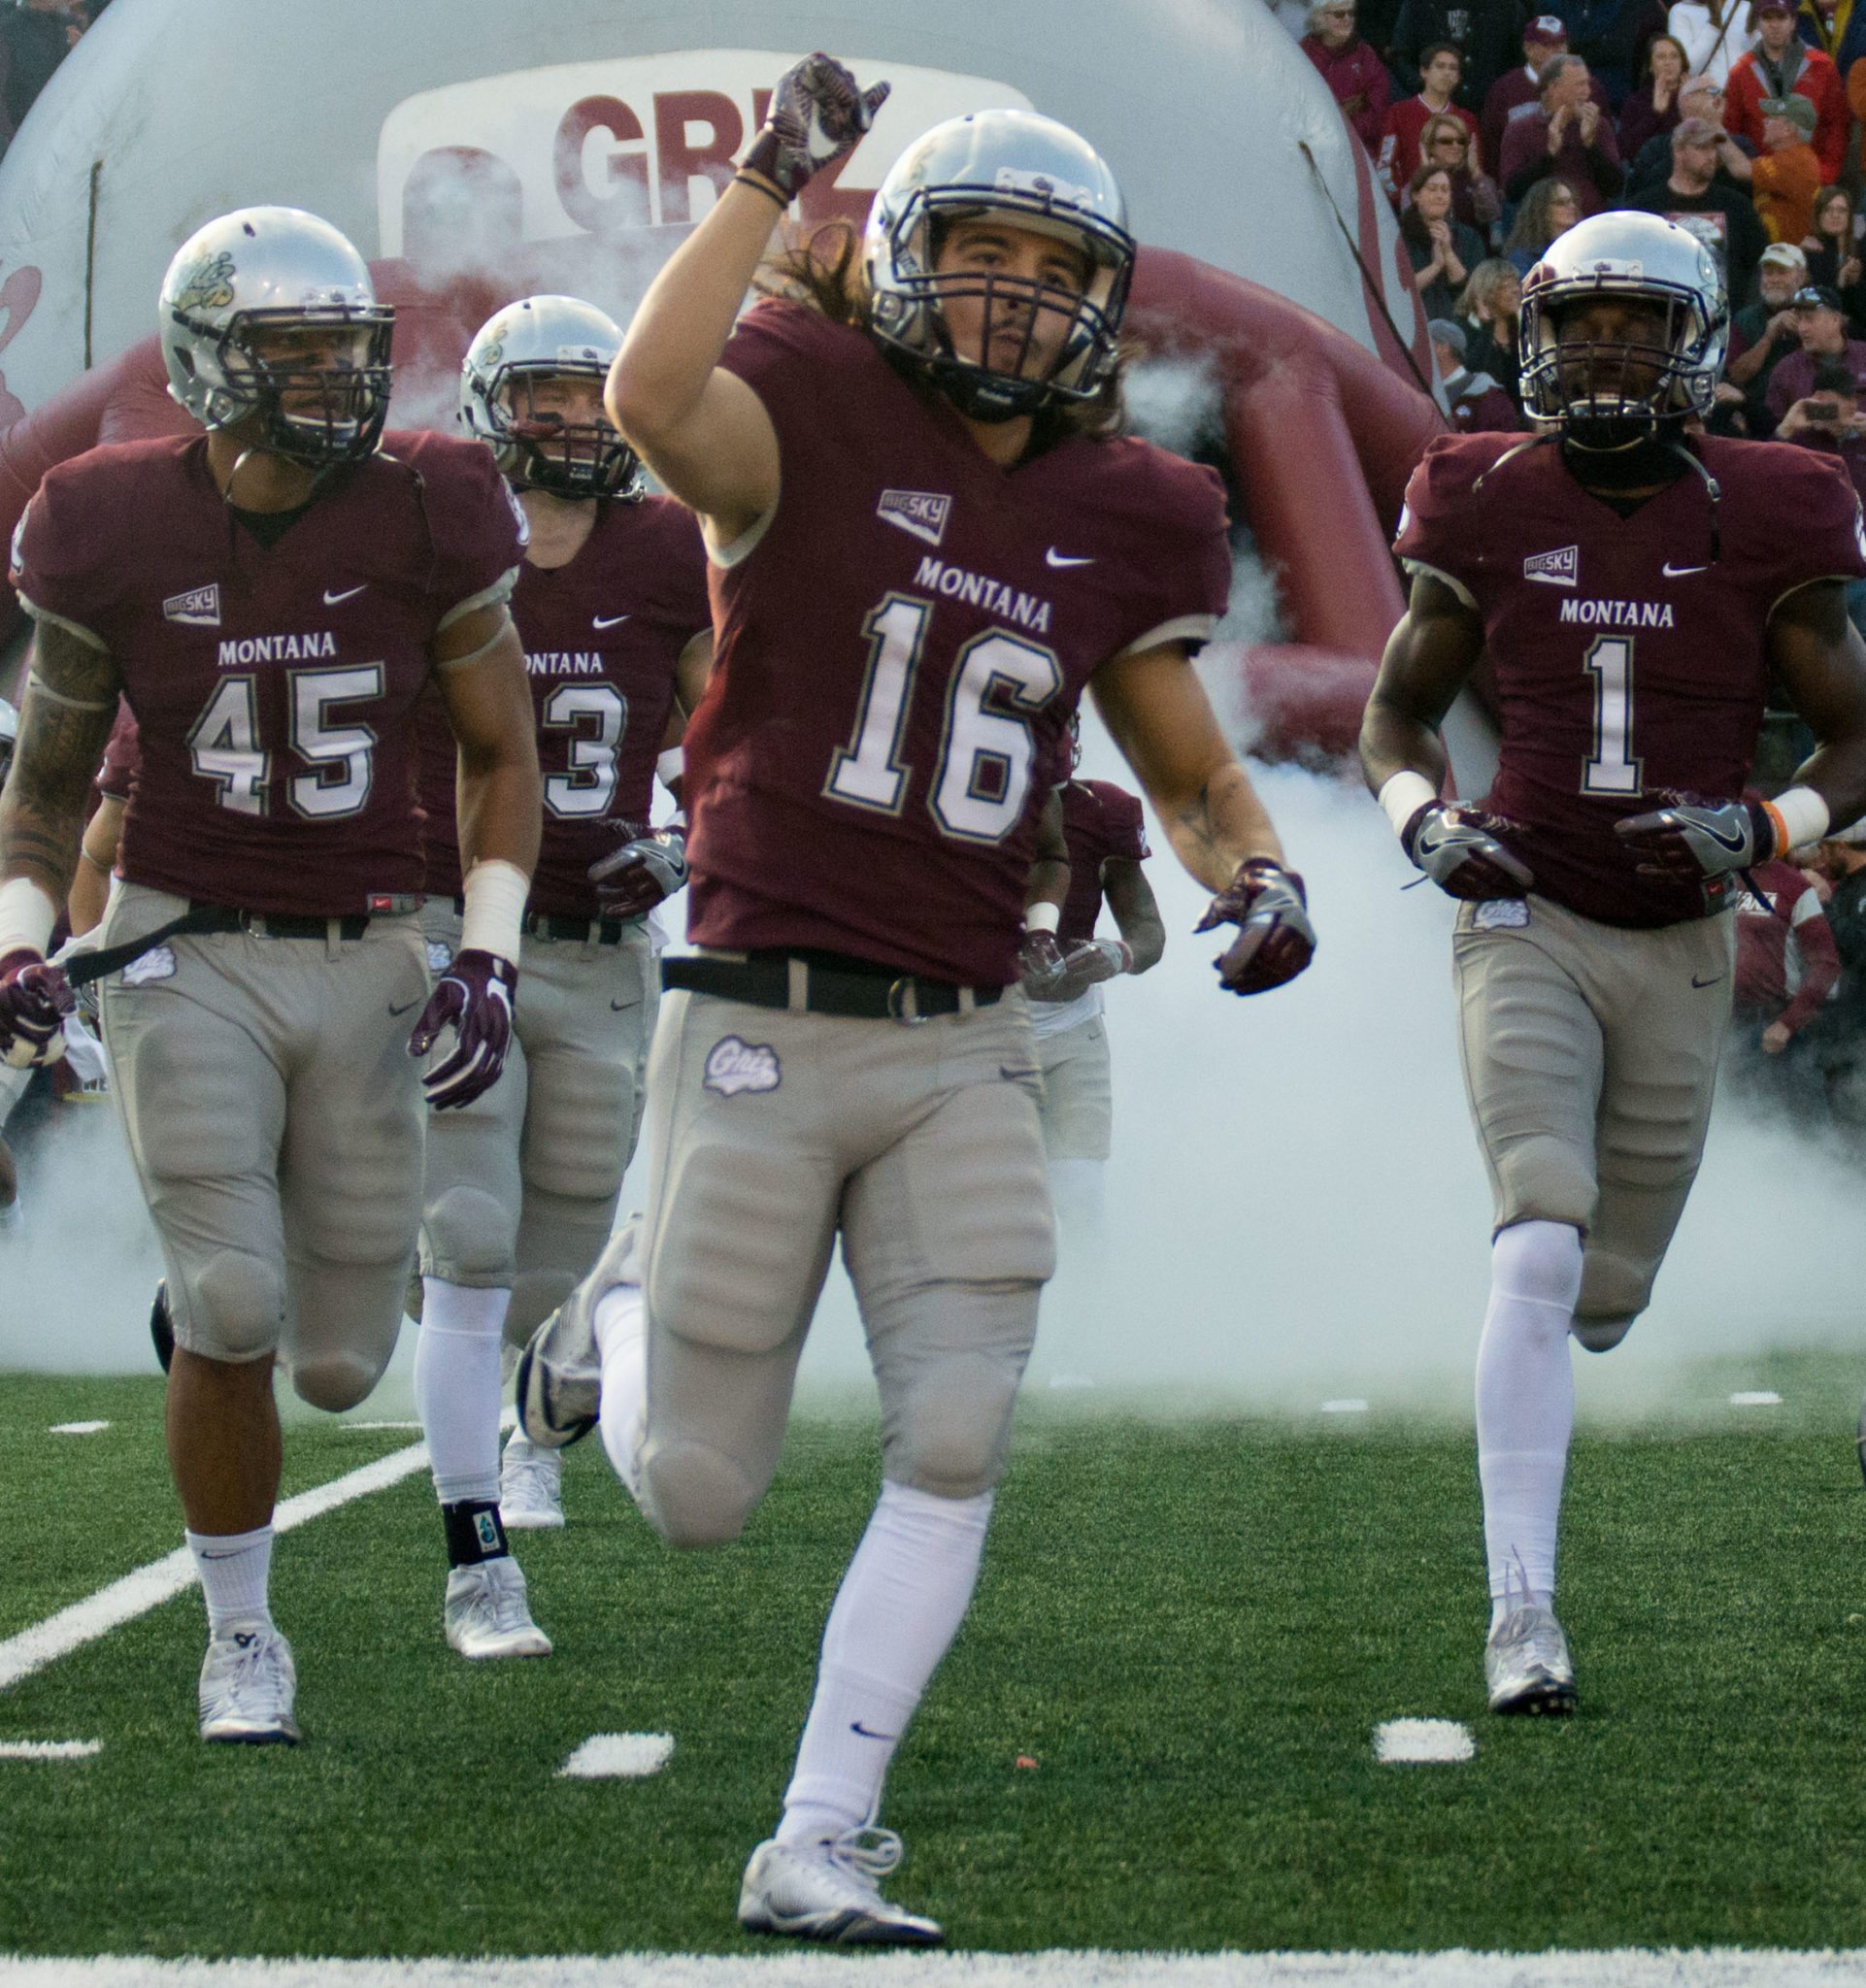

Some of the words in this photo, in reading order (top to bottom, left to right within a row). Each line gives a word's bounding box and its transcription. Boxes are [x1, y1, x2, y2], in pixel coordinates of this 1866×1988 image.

[217, 632, 336, 666] MONTANA
[914, 556, 1050, 633] MONTANA
[1560, 599, 1674, 627] MONTANA
[185, 661, 384, 820] 45
[543, 681, 628, 818] 3
[821, 590, 1064, 845] 16
[1580, 633, 1644, 797] 1
